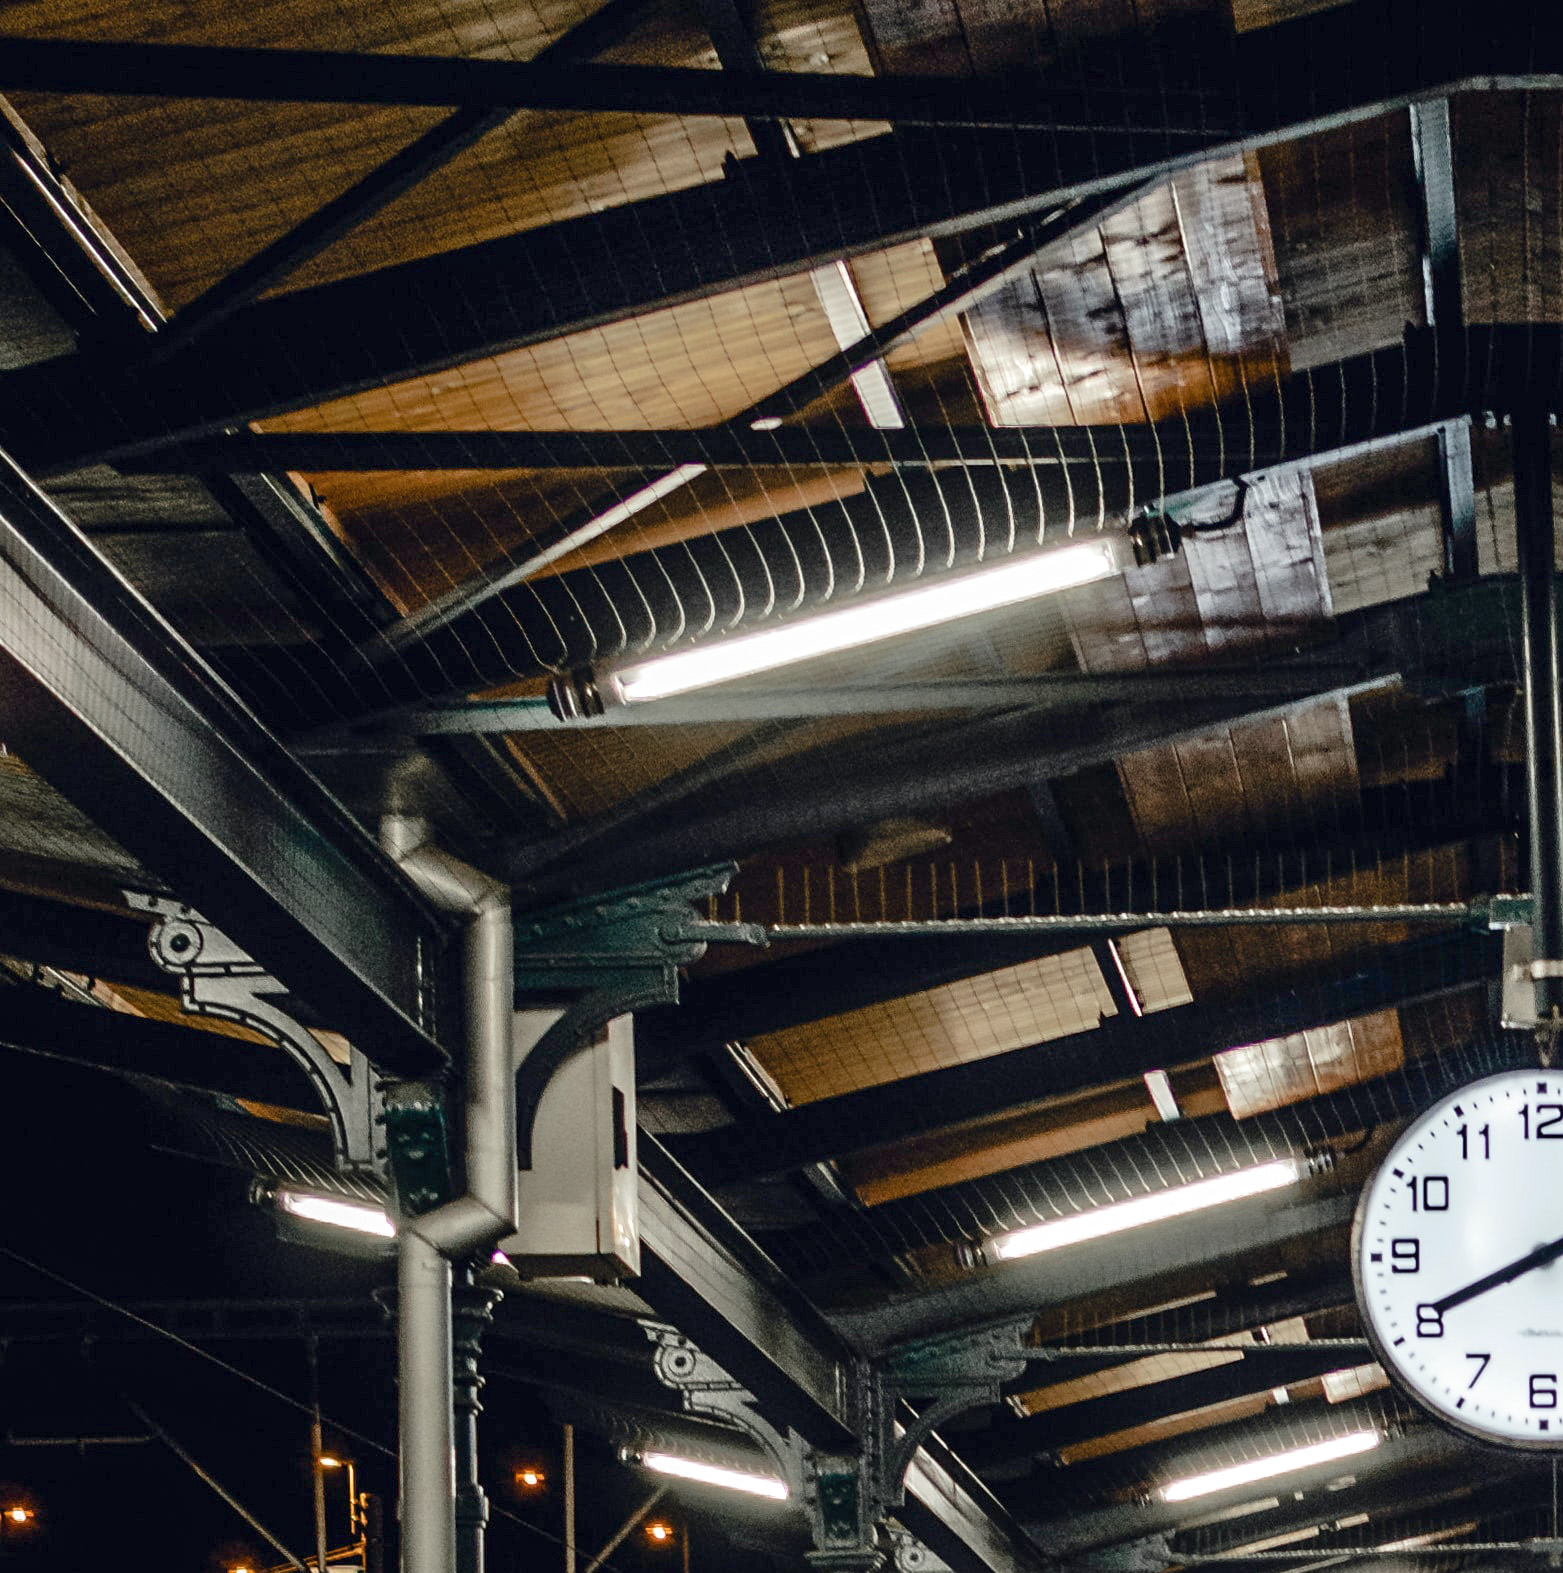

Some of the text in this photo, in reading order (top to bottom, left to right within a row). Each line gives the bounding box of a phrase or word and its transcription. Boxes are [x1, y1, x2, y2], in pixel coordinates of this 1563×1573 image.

[1456, 1123, 1490, 1160] 11
[1406, 1176, 1449, 1212] 10
[1391, 1238, 1420, 1274] 9
[1416, 1304, 1444, 1338] 8
[1466, 1353, 1491, 1389] 7
[1529, 1374, 1557, 1409] 6
